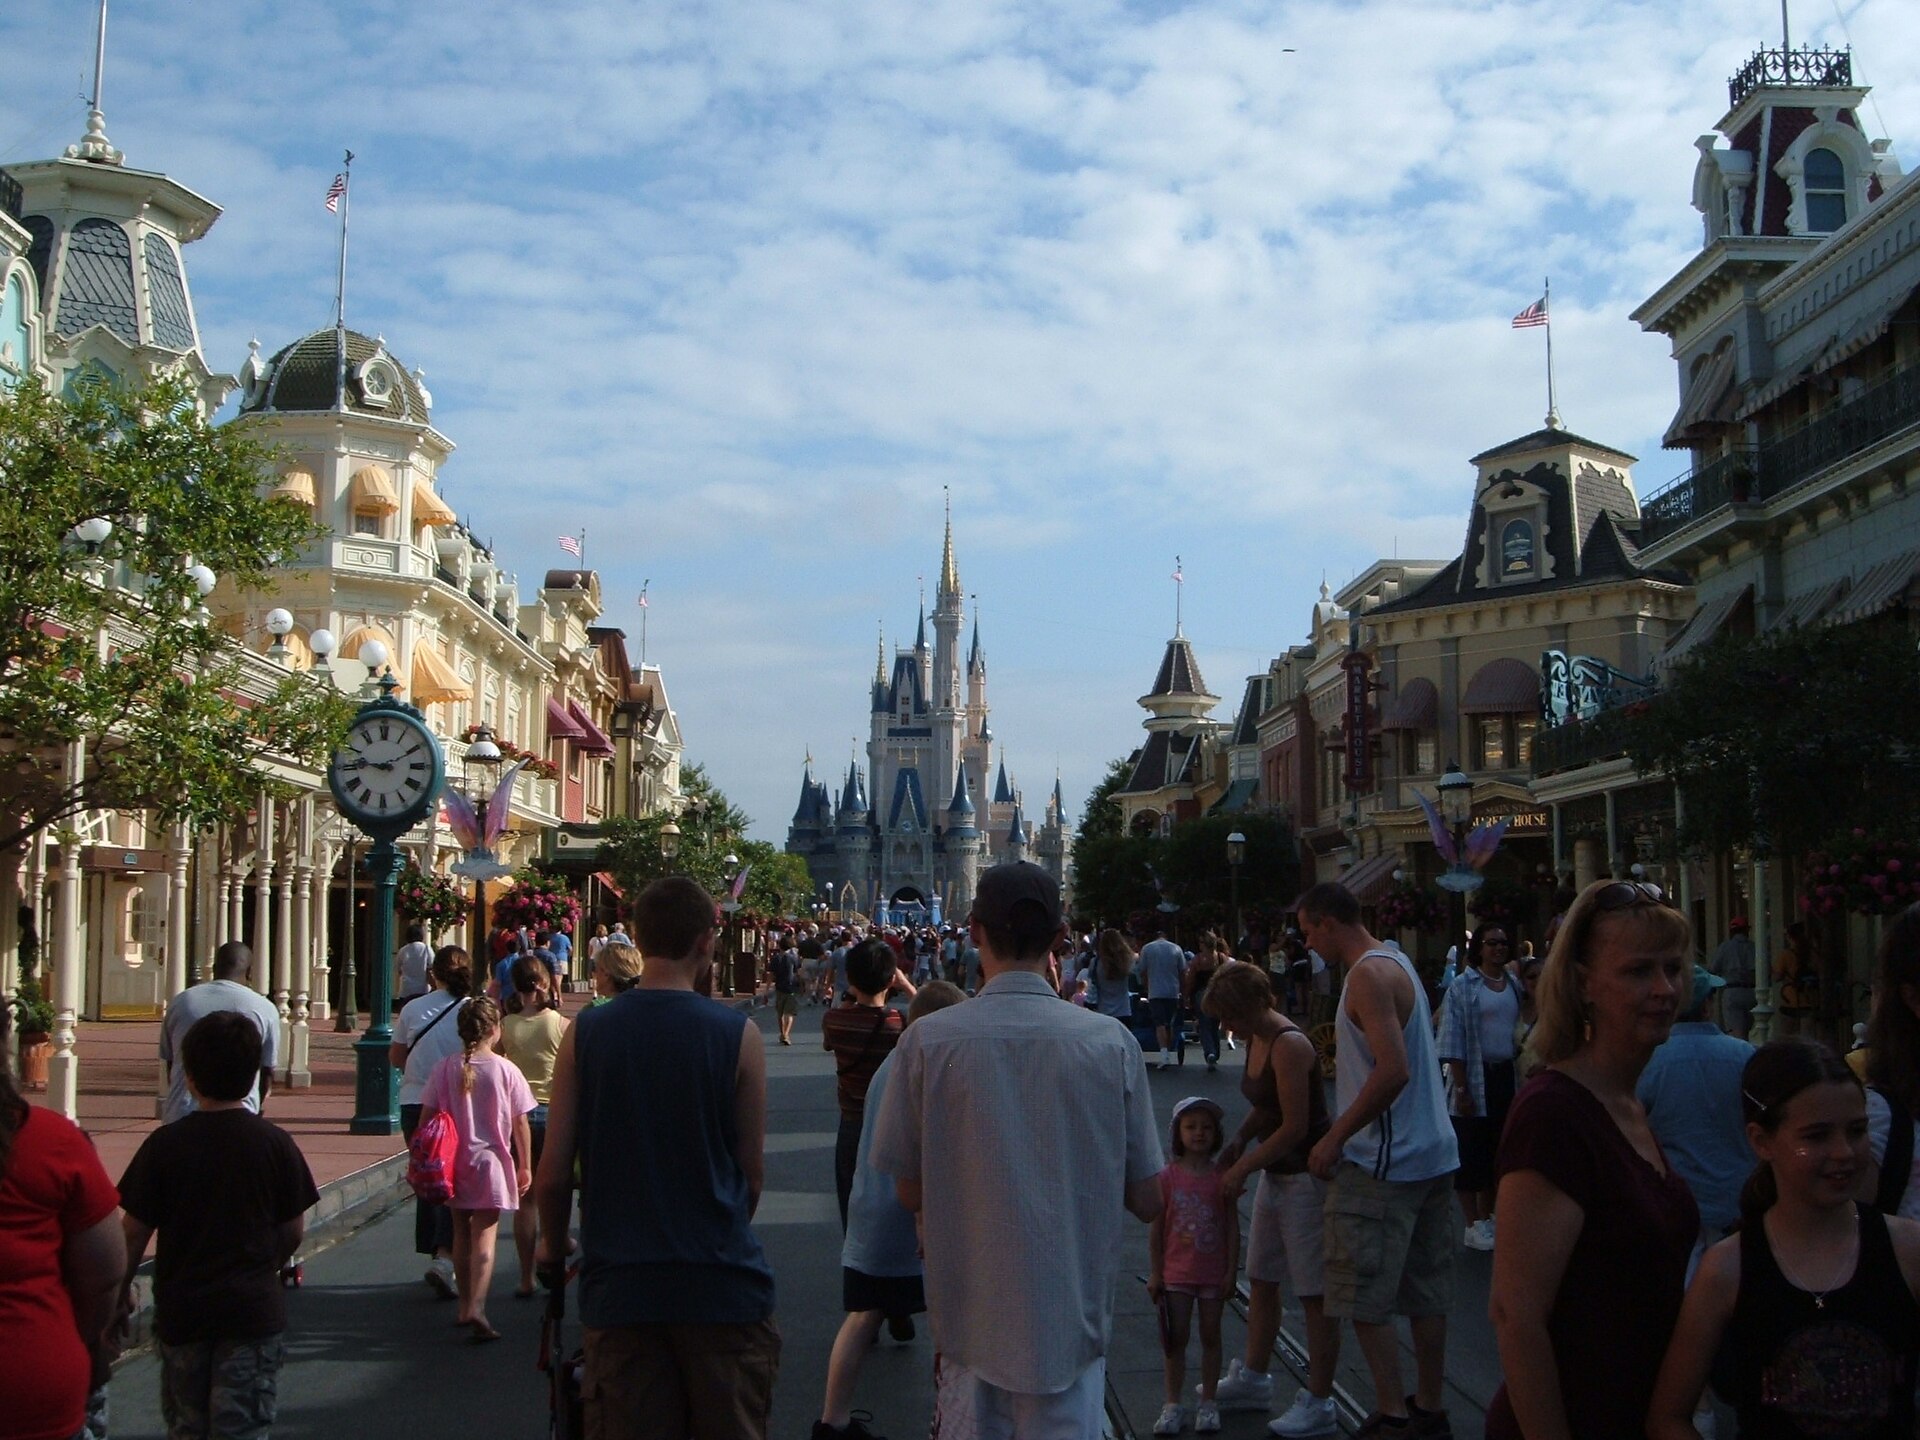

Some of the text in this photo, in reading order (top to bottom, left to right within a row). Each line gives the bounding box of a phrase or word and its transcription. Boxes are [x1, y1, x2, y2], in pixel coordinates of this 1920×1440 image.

[1353, 665, 1362, 776] MARKET HOUSE
[1513, 813, 1547, 827] HOUSE
